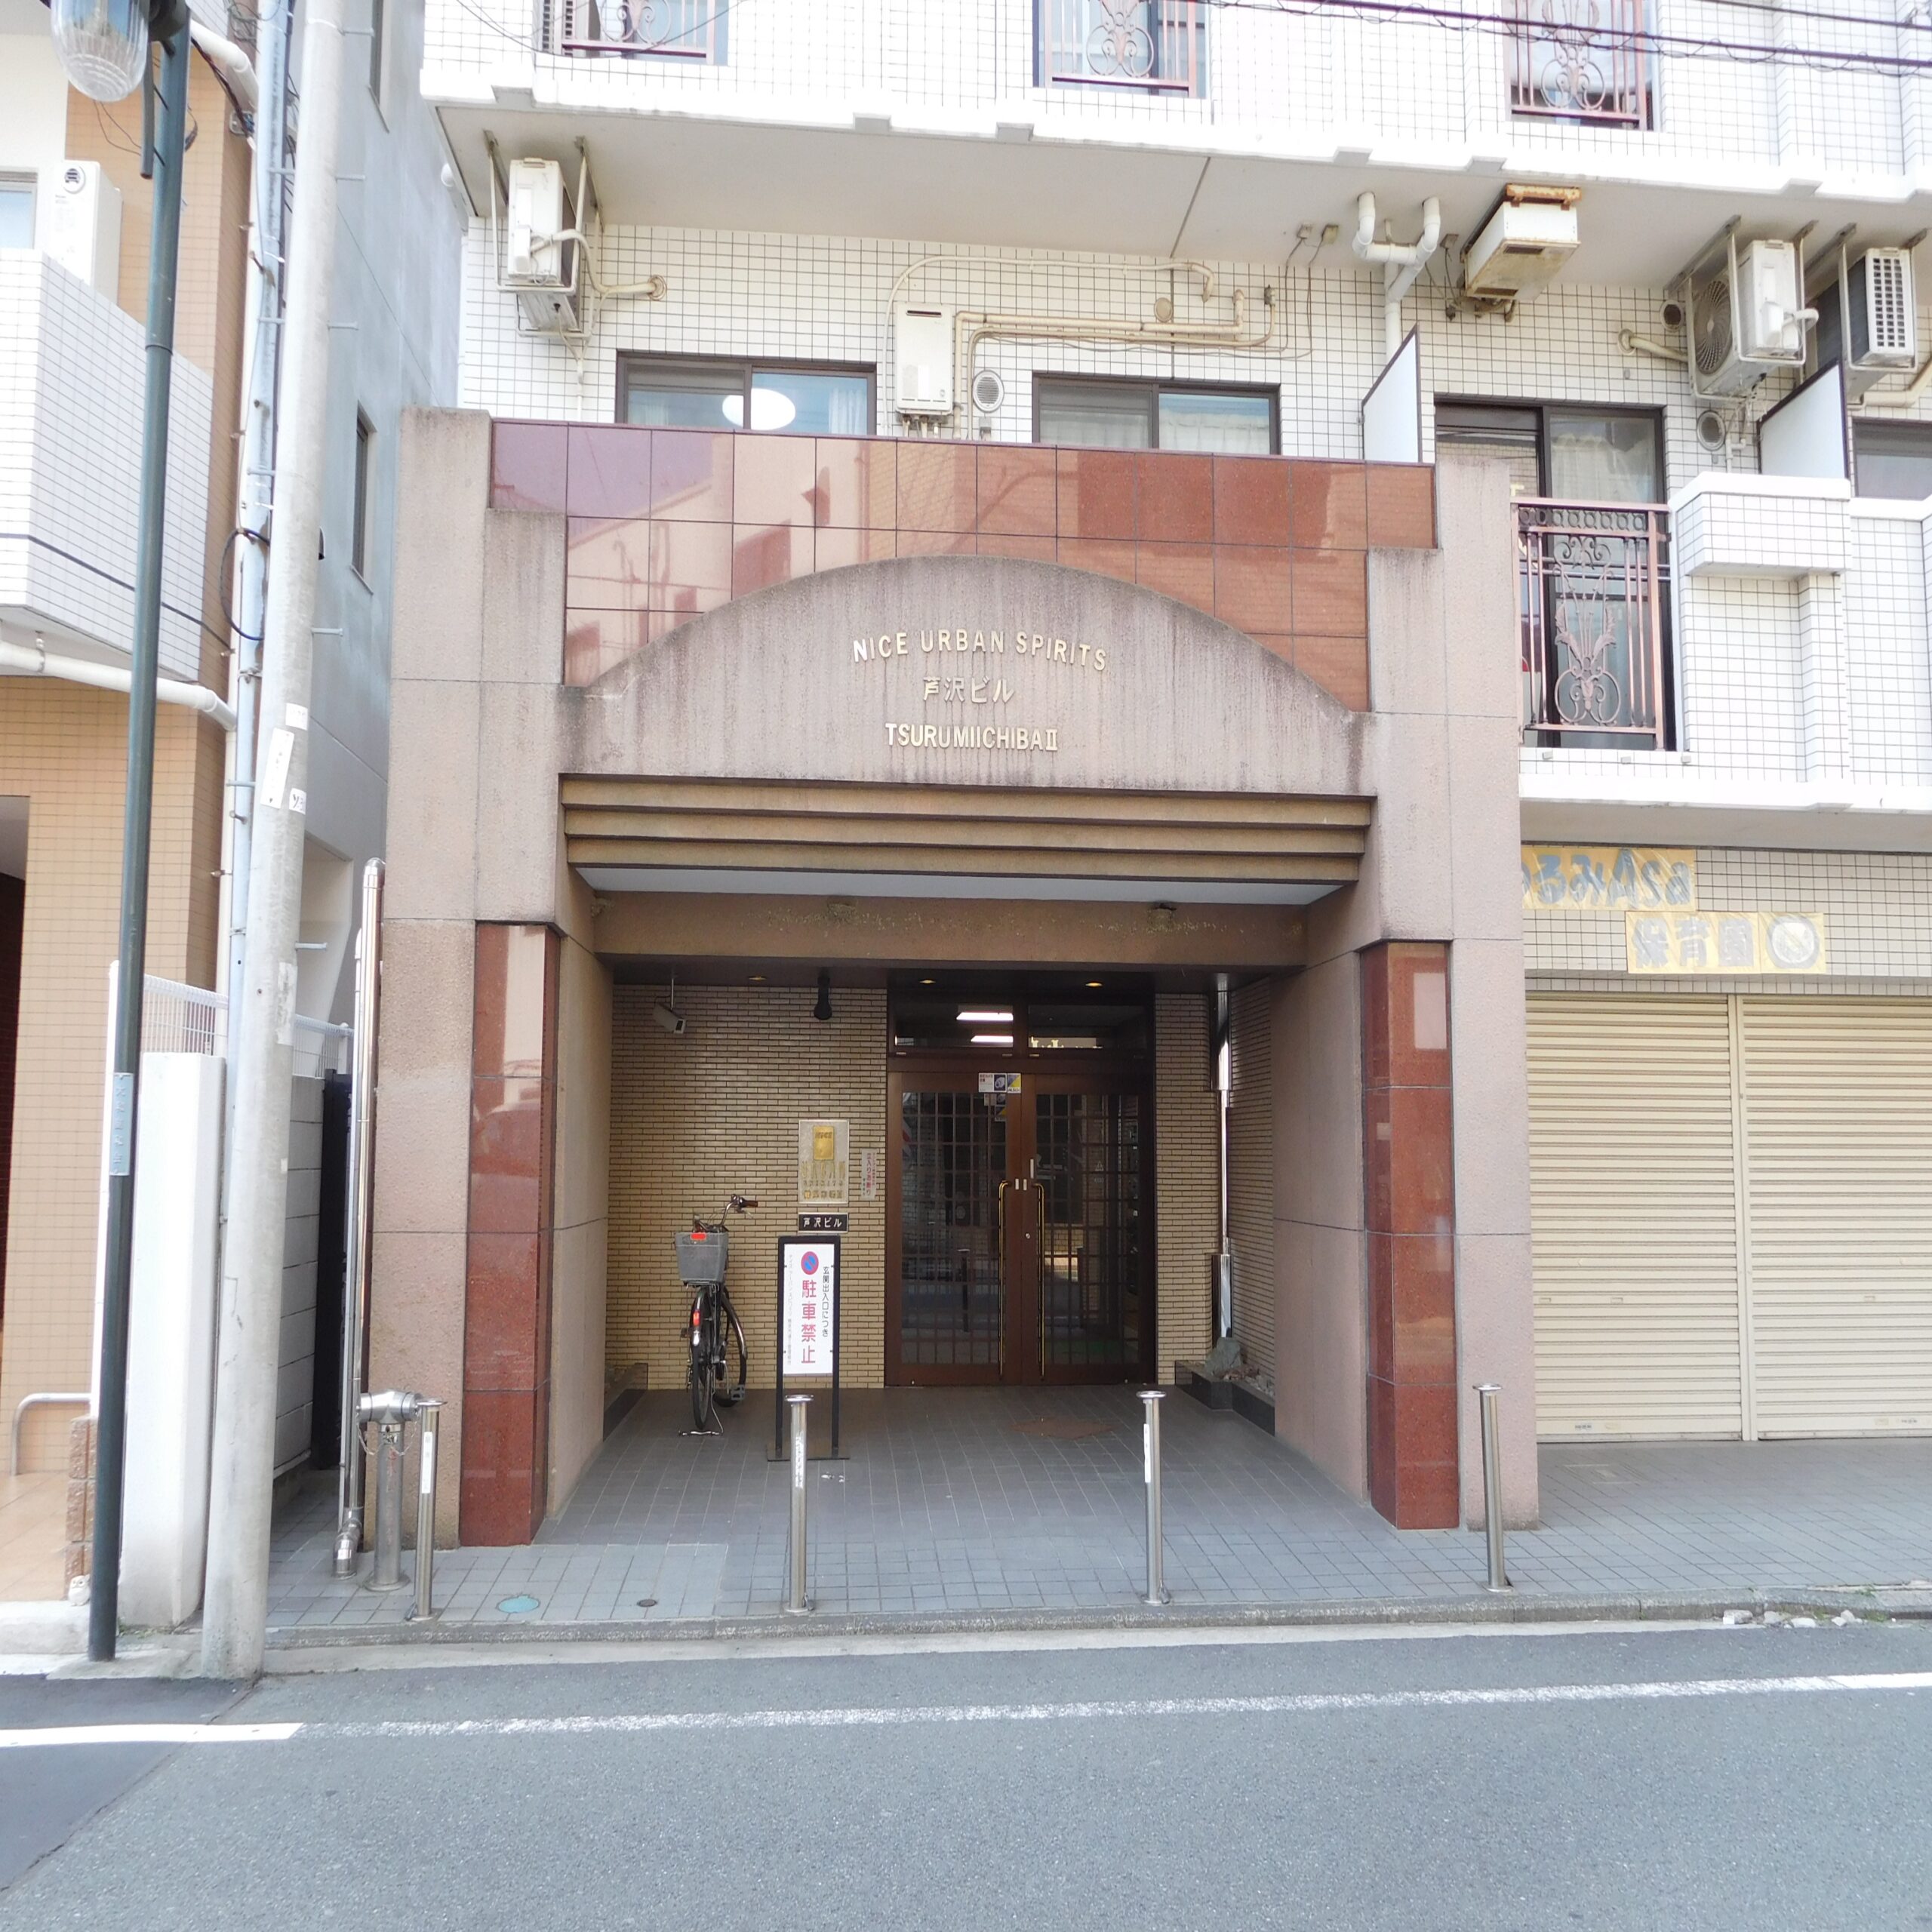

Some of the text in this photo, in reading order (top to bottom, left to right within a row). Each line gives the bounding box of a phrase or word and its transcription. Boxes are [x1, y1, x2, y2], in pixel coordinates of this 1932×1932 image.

[853, 629, 1106, 671] NICE URBAN SPIRITS
[922, 677, 1014, 703] 芦沢ビル
[803, 1217, 842, 1228] 芦沢ビル
[801, 1279, 817, 1364] 駐車禁止
[821, 1266, 829, 1337] 玄関出入口につき
